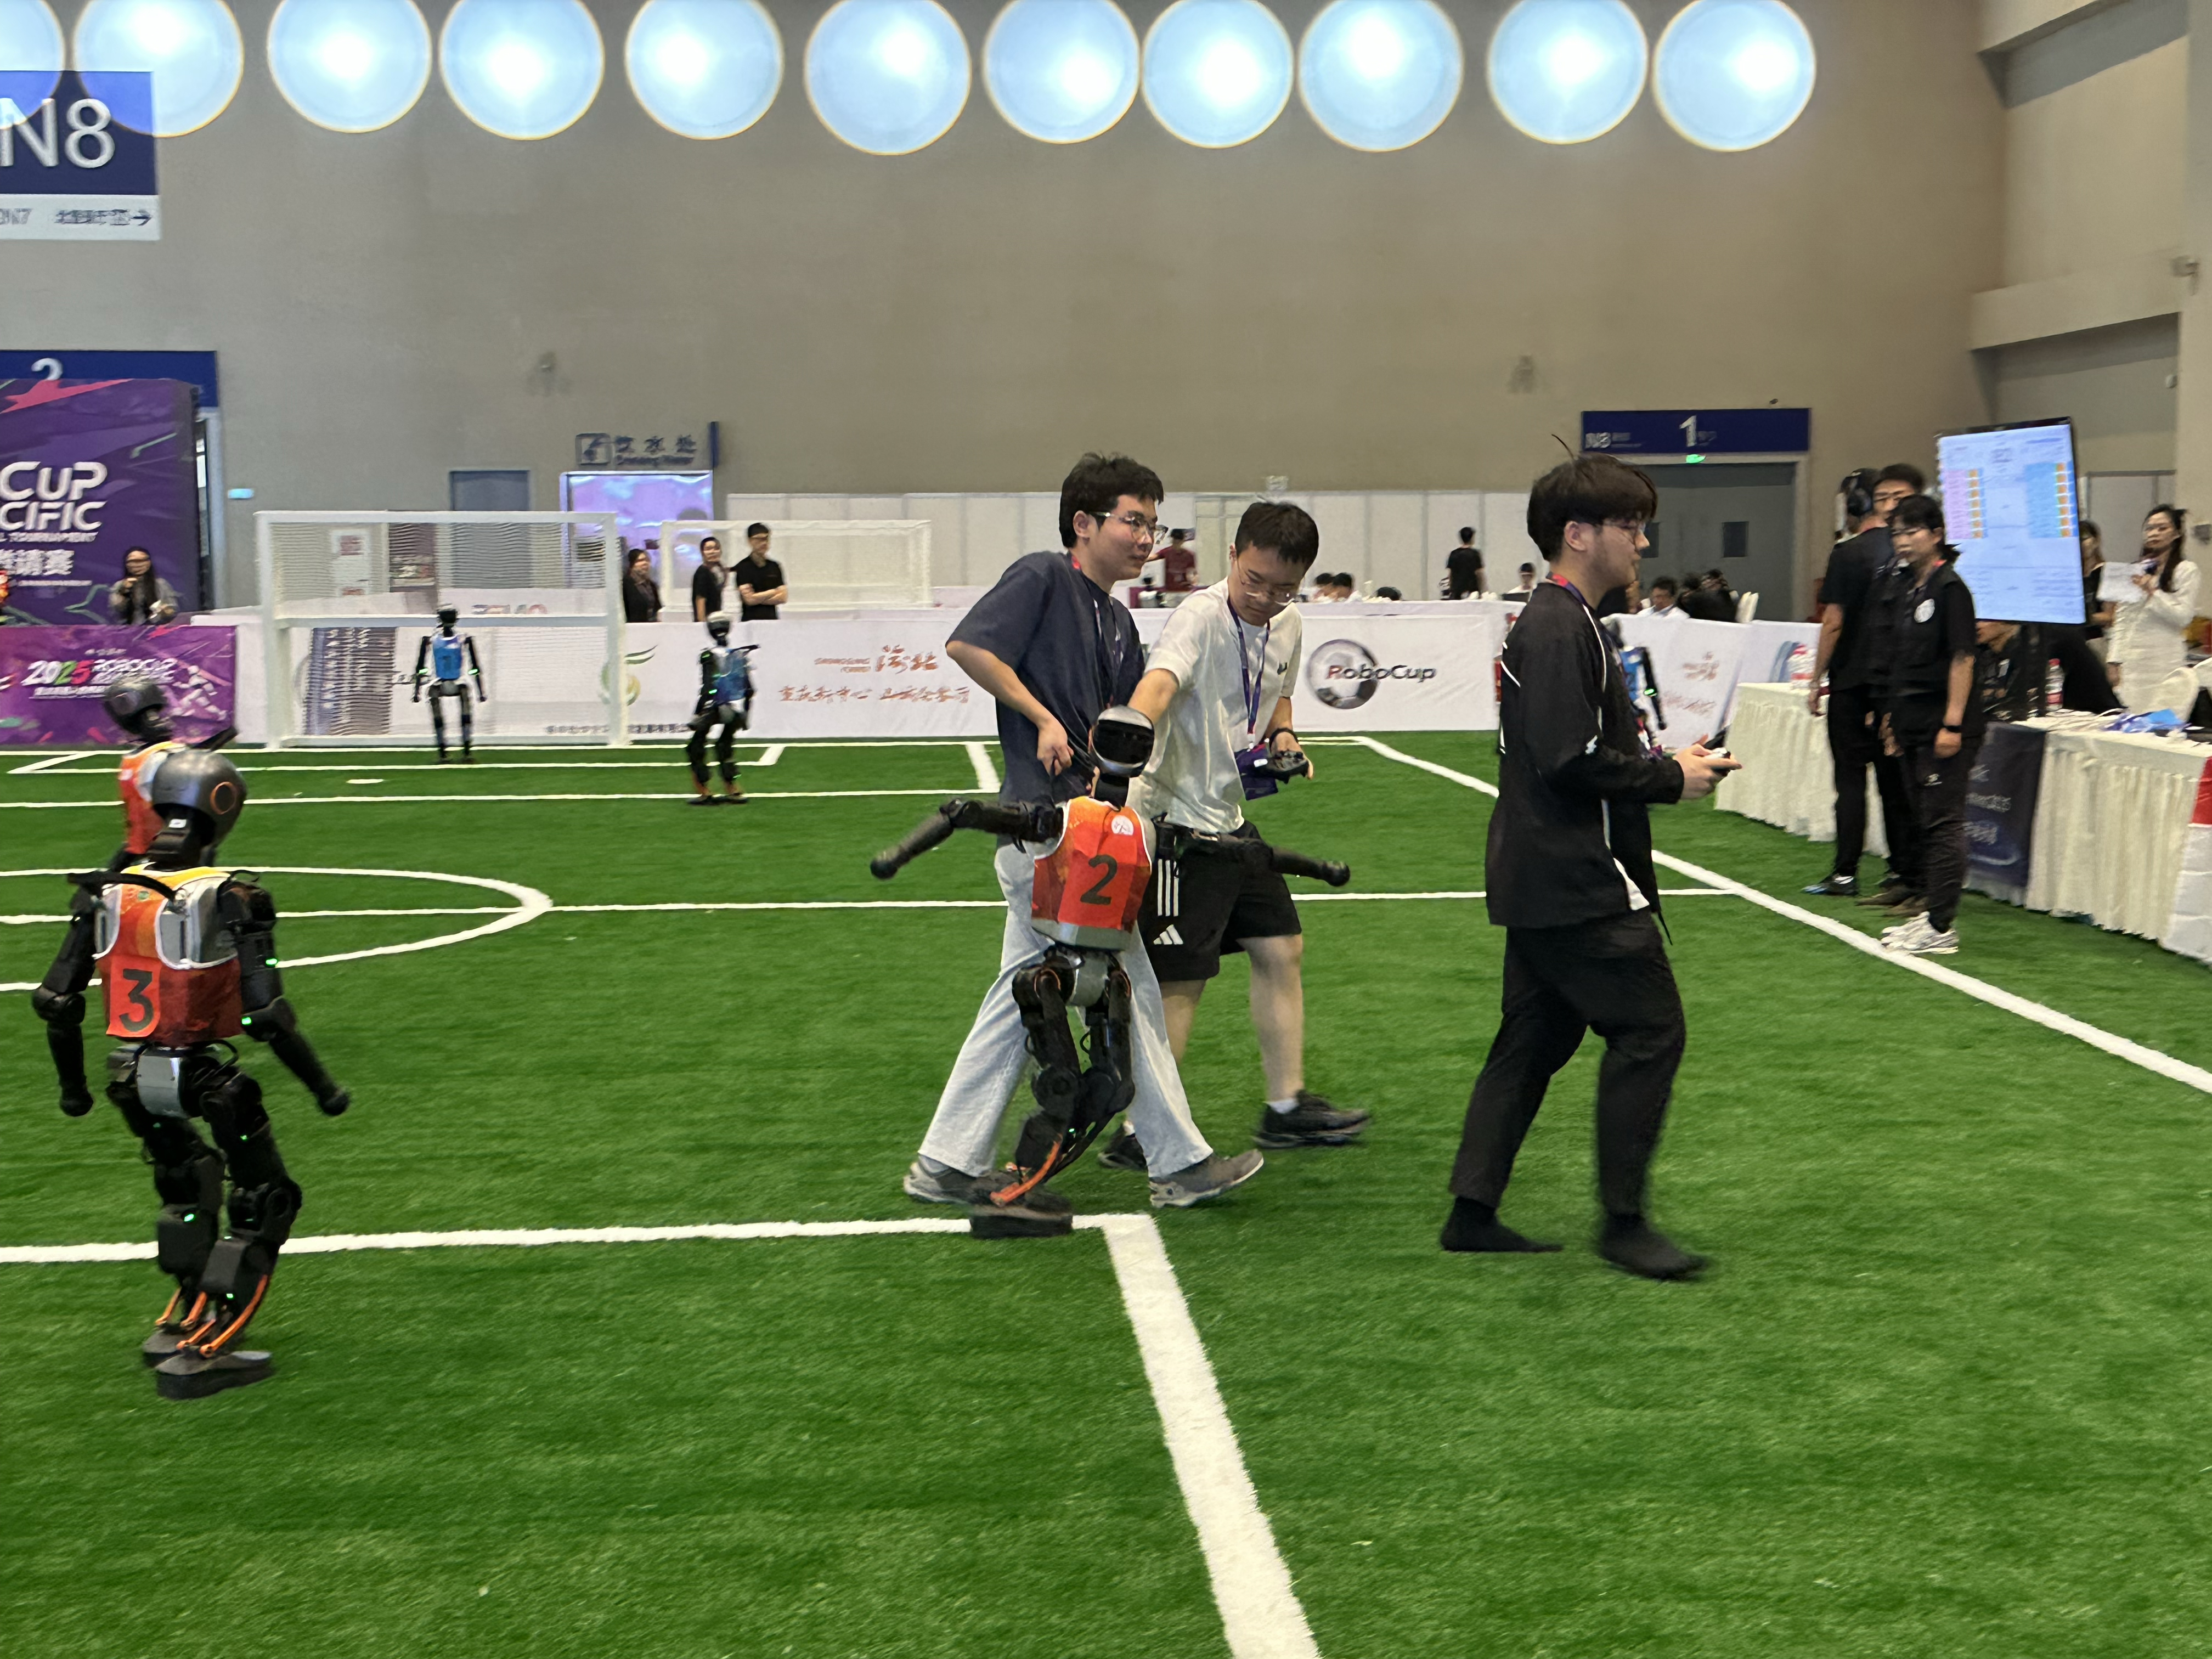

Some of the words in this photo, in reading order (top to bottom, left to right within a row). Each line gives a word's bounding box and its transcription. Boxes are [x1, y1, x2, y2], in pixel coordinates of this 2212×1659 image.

[0, 97, 115, 168] N8
[1679, 415, 1697, 447] 1
[20, 660, 94, 686] 2025
[1079, 854, 1118, 905] 2
[119, 969, 154, 1032] 3
